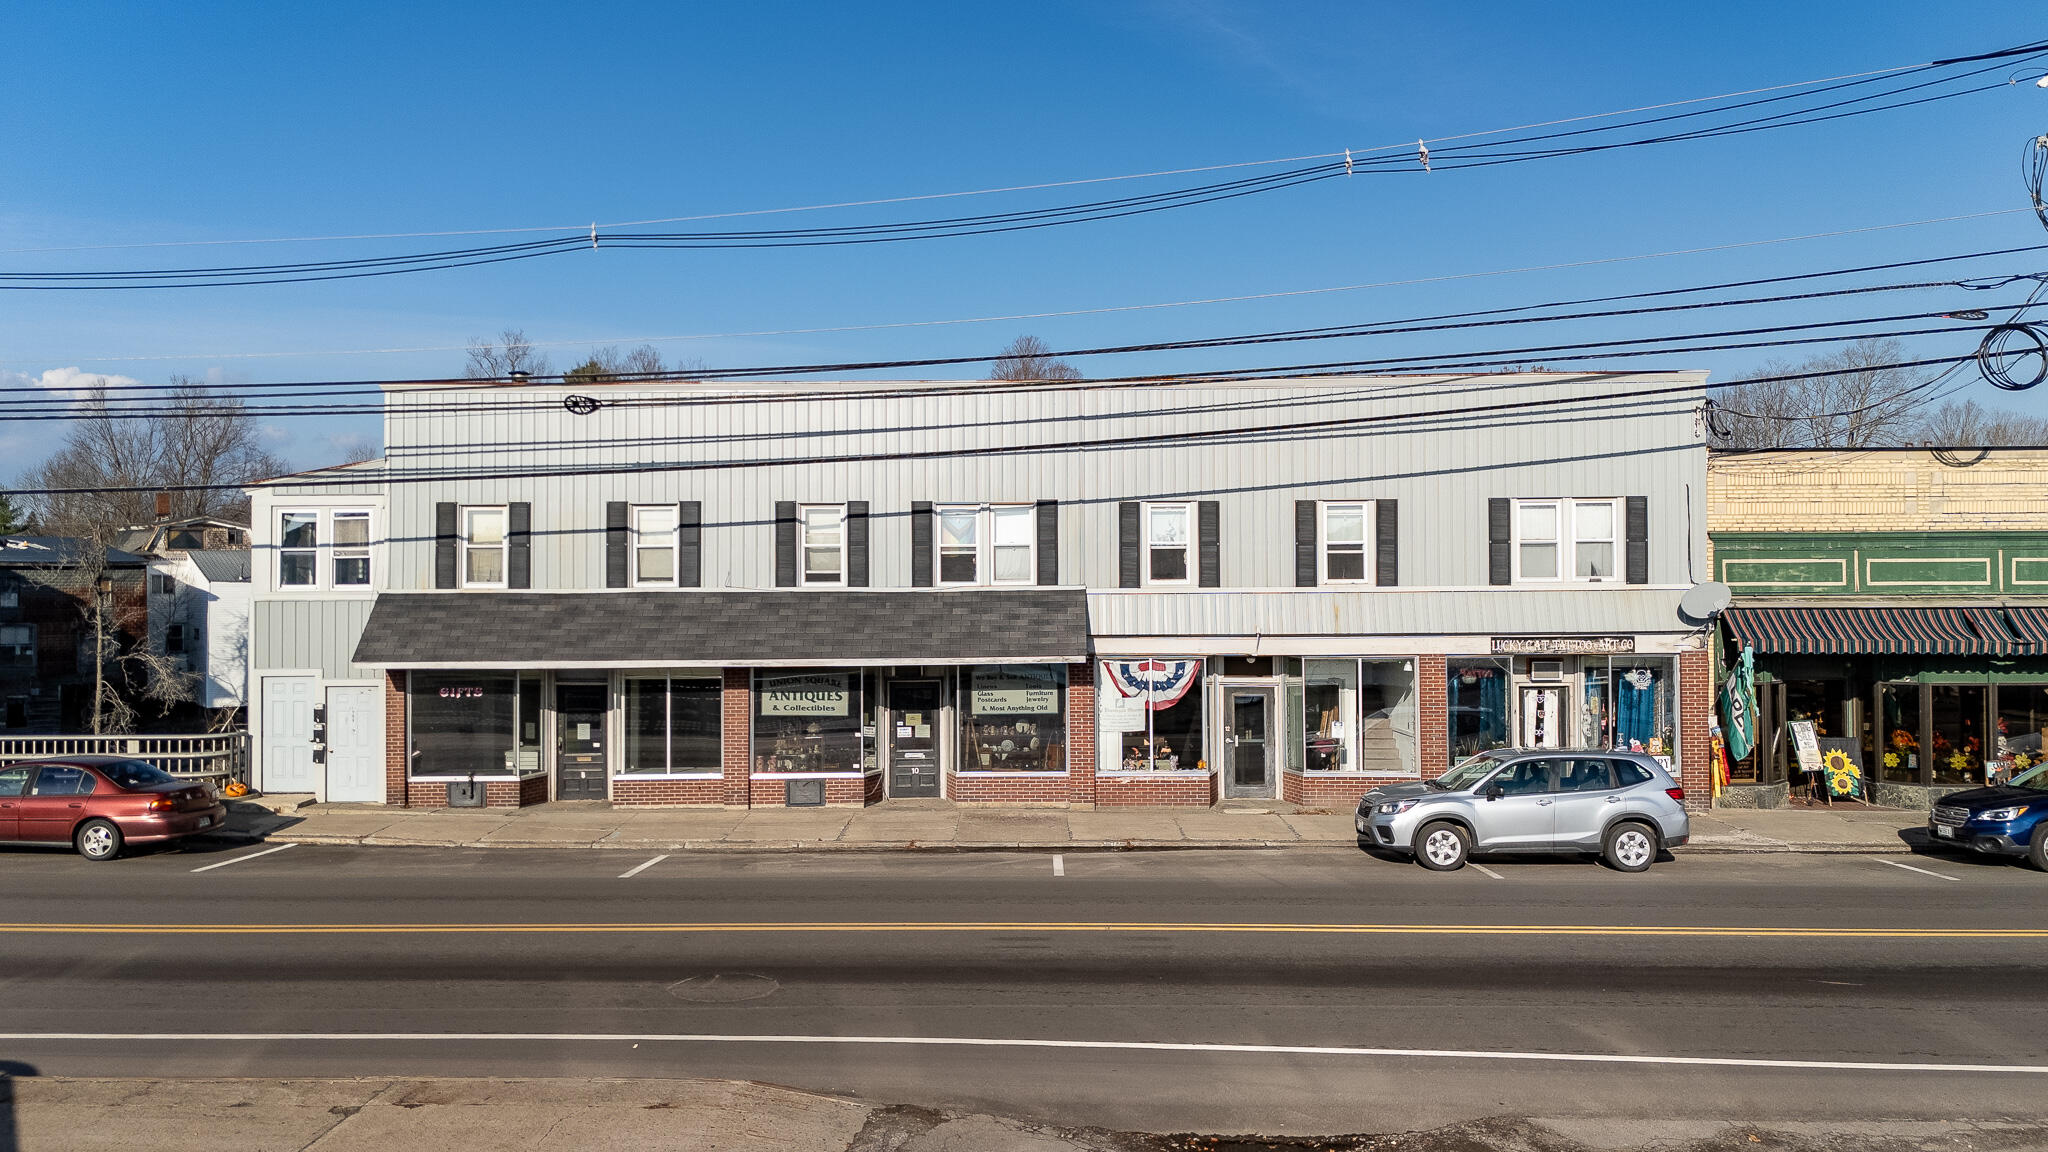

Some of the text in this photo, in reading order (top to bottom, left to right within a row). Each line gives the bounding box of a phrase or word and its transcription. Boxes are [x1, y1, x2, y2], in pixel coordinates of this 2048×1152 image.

[1491, 639, 1524, 652] LUCKY
[1525, 640, 1549, 650] CAT
[1553, 640, 1593, 650] TATTOO
[1599, 638, 1620, 650] ART
[769, 675, 842, 688] UNION SQUARE
[439, 687, 484, 699] GIFTS
[768, 691, 844, 703] ANTIQUES
[1026, 696, 1049, 704] Jewelry
[772, 704, 836, 712] & Collectibles
[911, 767, 920, 775] 10
